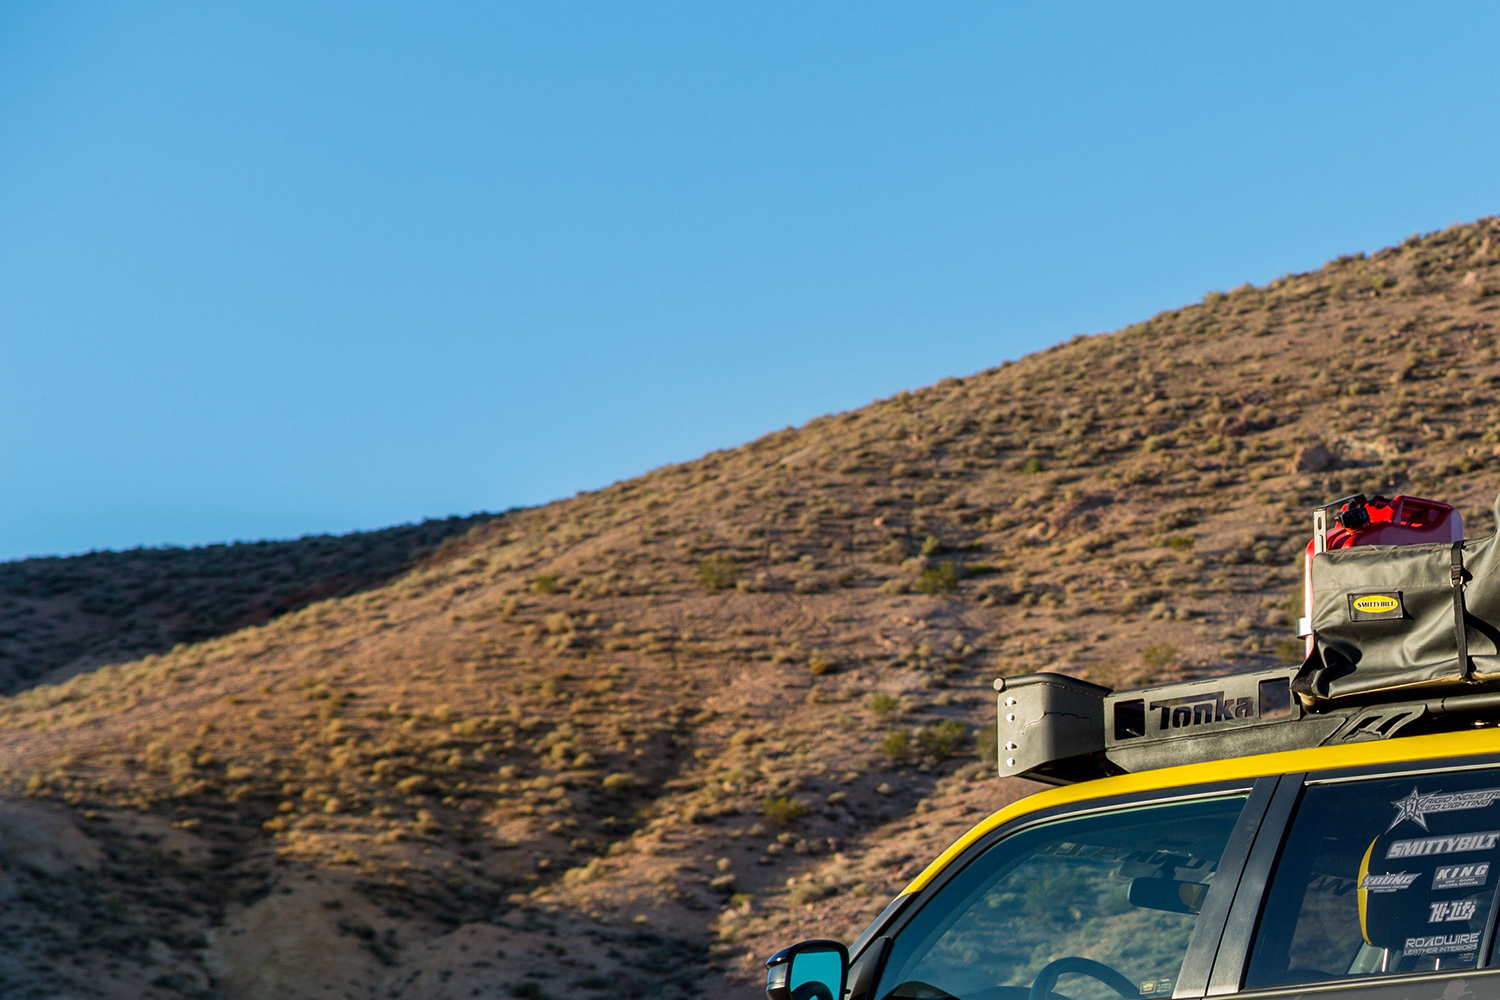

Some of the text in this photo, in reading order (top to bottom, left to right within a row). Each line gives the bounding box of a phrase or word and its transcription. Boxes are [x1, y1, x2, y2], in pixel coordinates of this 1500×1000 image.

[1357, 600, 1395, 608] SMITTYBILT
[1149, 691, 1255, 731] Tonka
[1424, 795, 1453, 804] RIGID
[1441, 800, 1488, 810] LIGHTING
[1388, 832, 1500, 858] SMITTYBILT
[1436, 864, 1489, 880] KING
[1405, 931, 1481, 948] ROADWIRE
[1403, 943, 1478, 957] LEATHER INTERIORS
